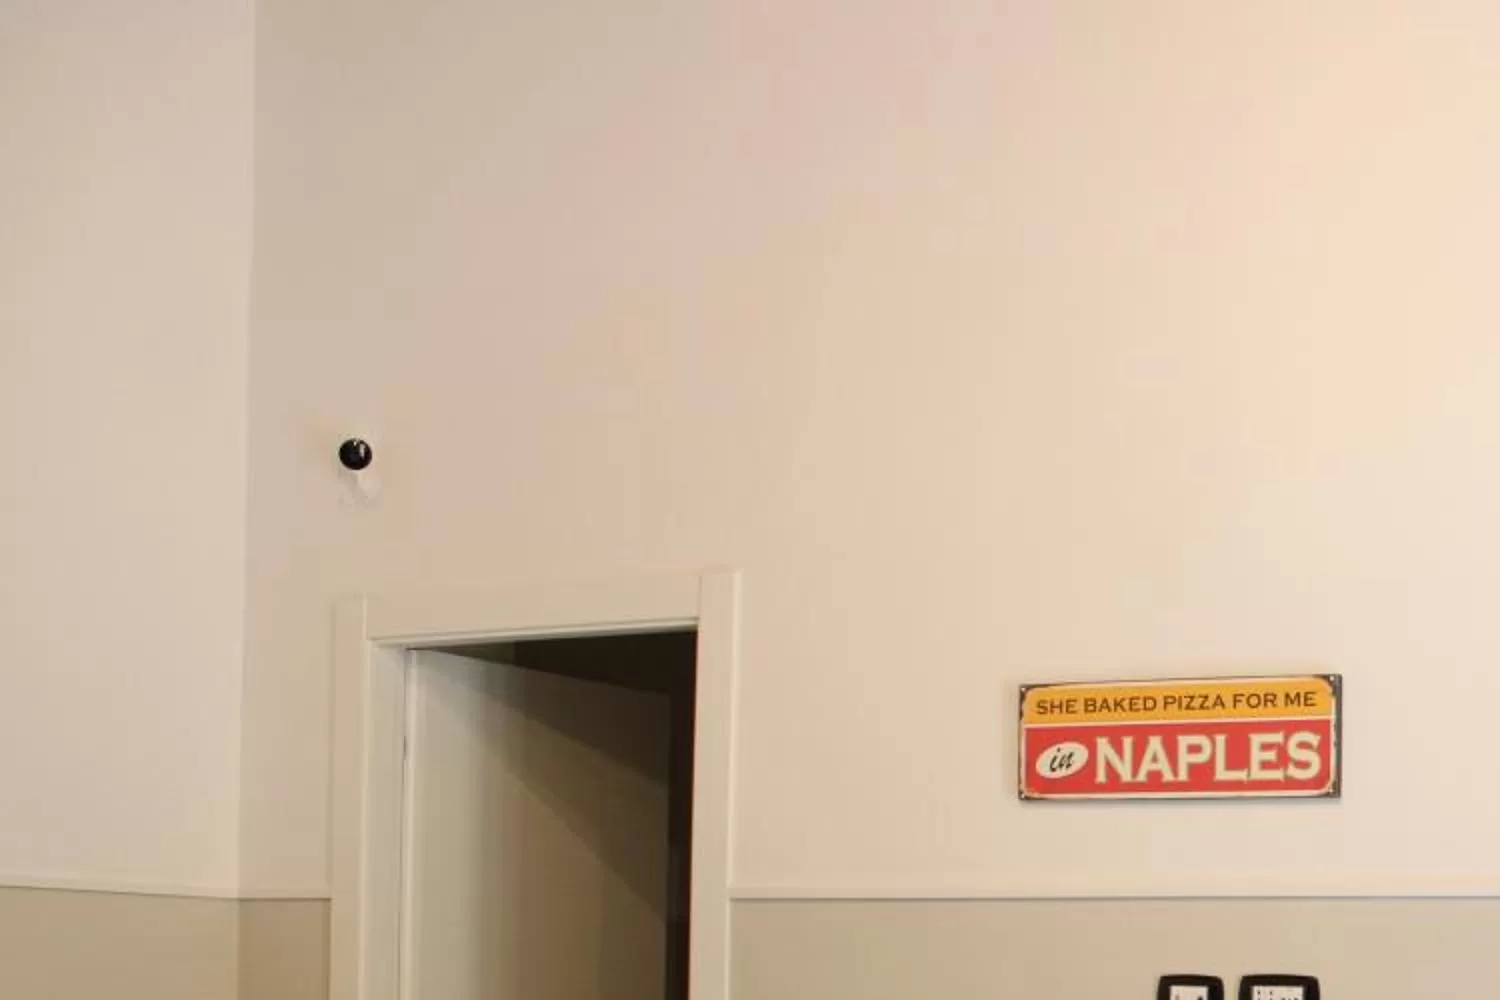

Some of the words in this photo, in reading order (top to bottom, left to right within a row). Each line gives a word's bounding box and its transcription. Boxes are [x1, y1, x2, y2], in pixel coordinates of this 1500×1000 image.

[1036, 698, 1078, 715] SHE
[1083, 695, 1157, 714] BAKED
[1163, 694, 1226, 712] PIZZA
[1232, 692, 1278, 709] FOR
[1283, 690, 1317, 707] ME
[1049, 747, 1076, 774] in
[1094, 731, 1322, 784] NAPLES
